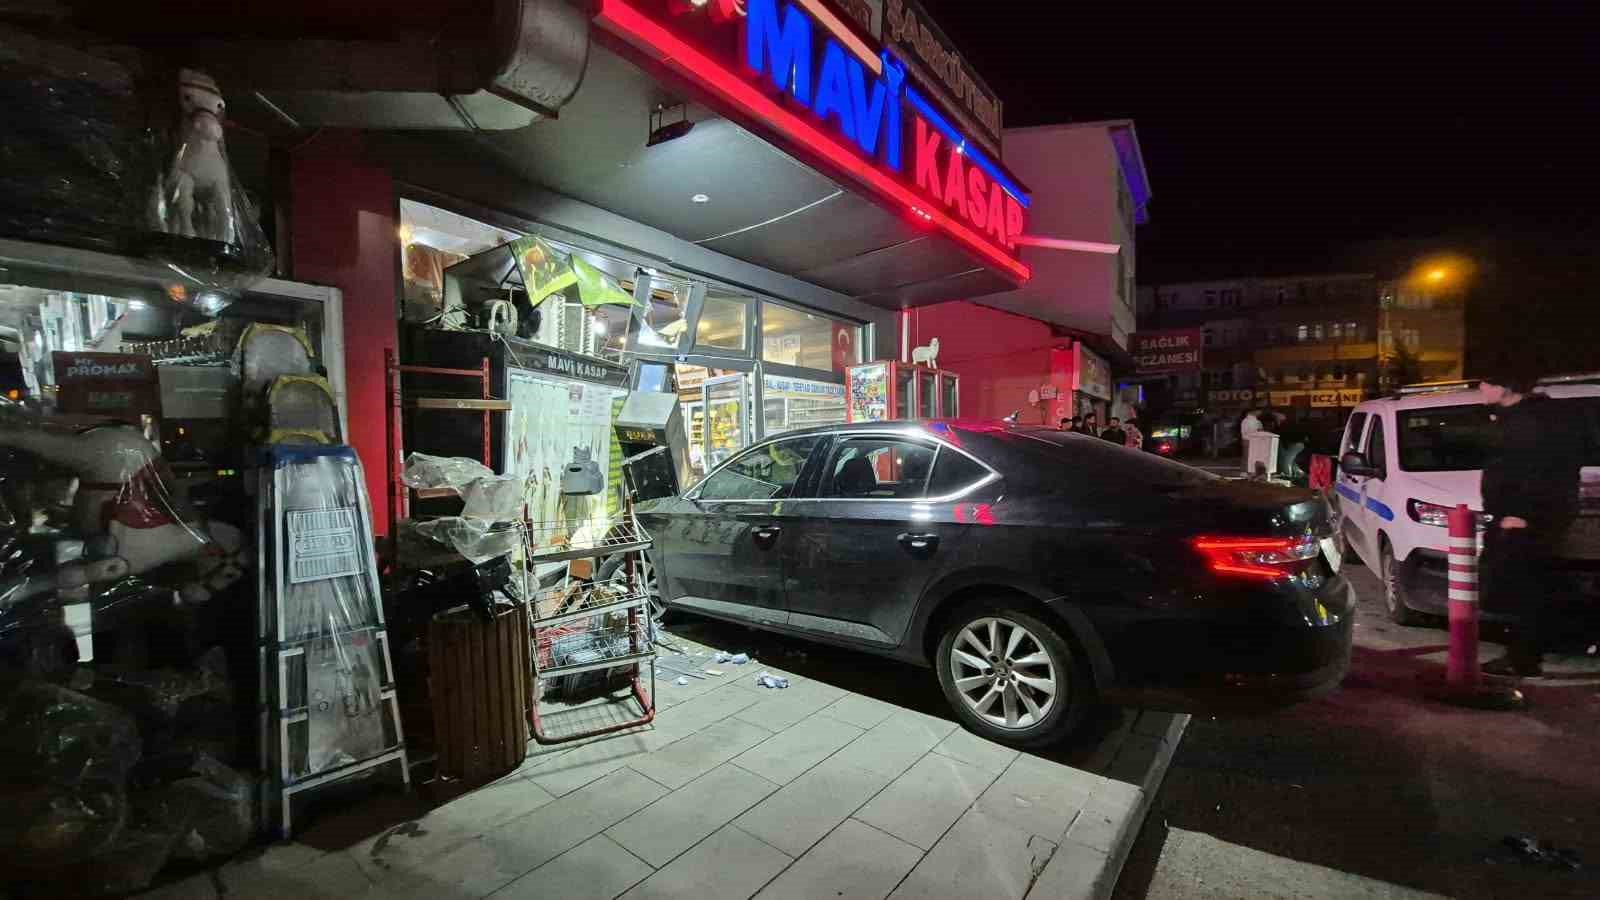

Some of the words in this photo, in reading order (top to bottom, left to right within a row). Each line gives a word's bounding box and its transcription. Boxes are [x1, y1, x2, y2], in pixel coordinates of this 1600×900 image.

[746, 0, 905, 173] MAVİ
[915, 115, 1024, 250] KASAP
[1140, 335, 1191, 350] SAĞLIK
[547, 354, 575, 377] MAVİ
[576, 362, 608, 380] KASAP
